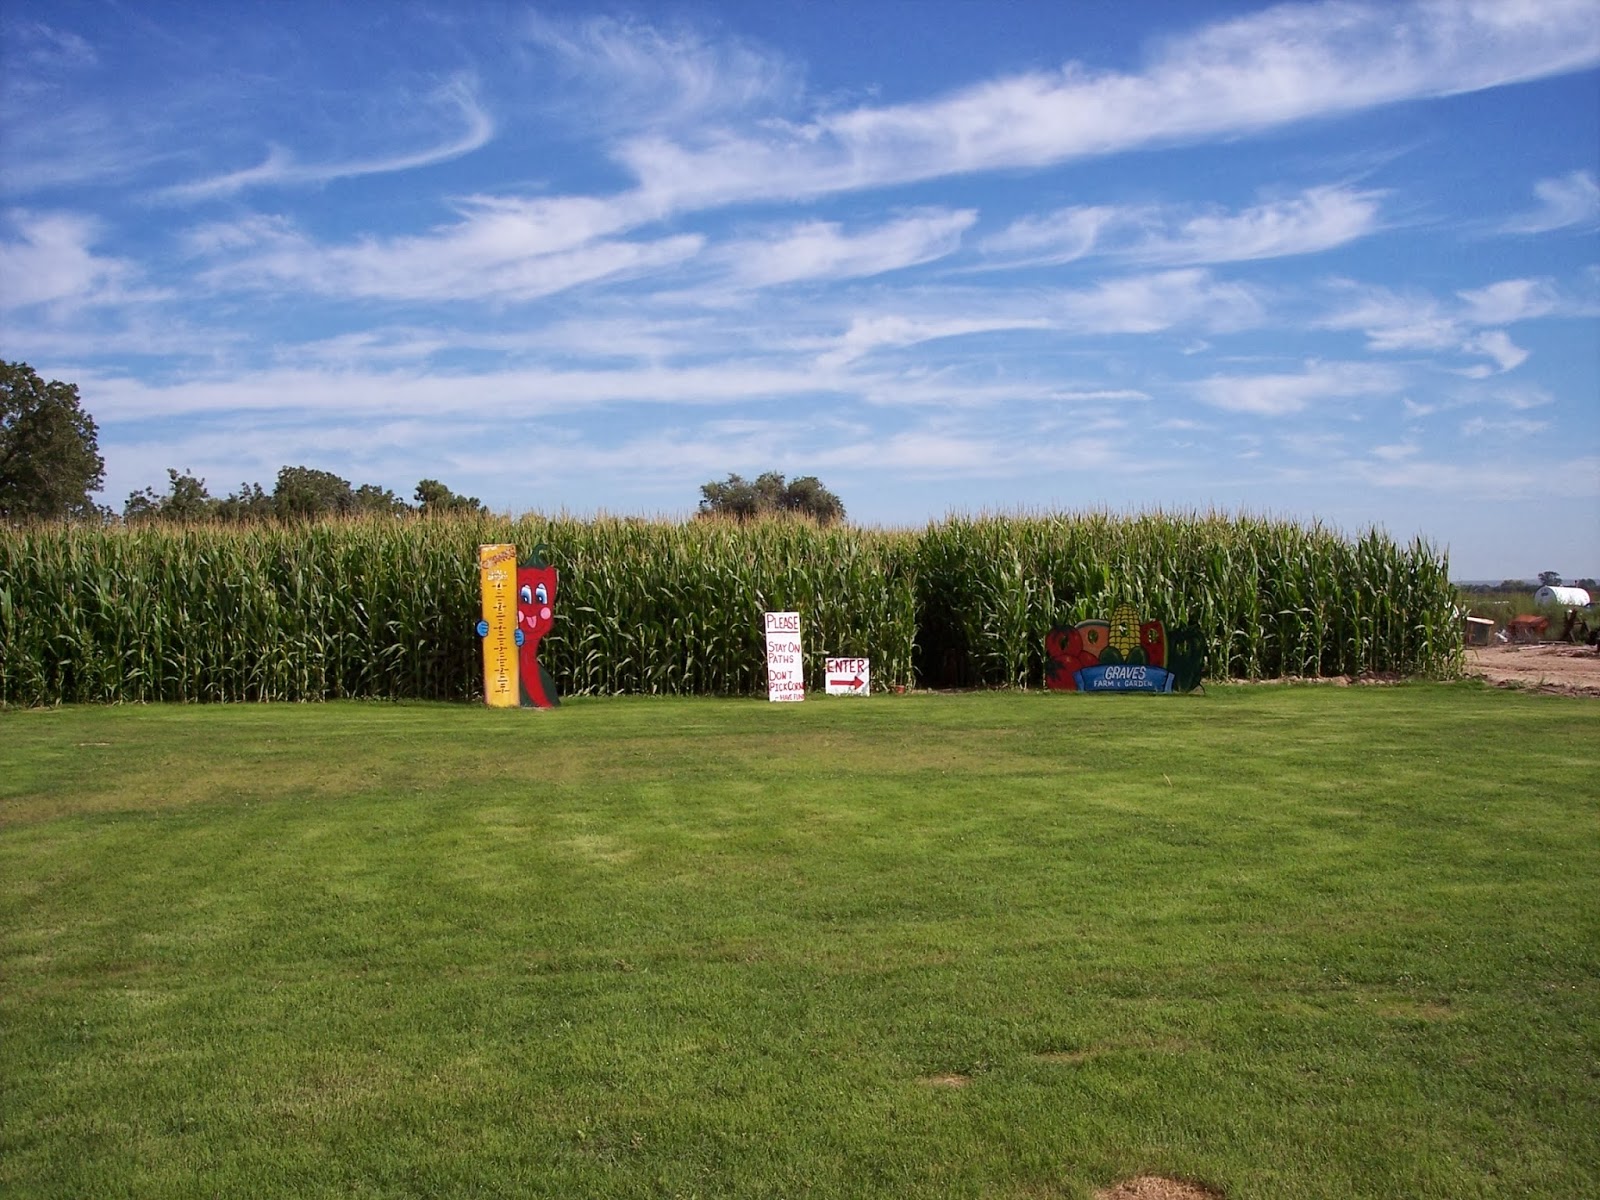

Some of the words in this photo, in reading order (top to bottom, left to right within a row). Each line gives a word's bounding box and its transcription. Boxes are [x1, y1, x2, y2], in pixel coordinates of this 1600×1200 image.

[767, 614, 798, 629] PLEASE
[768, 641, 787, 653] STAY
[788, 641, 801, 653] ON
[768, 653, 794, 664] PATHS
[827, 659, 865, 673] ENTER
[1105, 666, 1146, 680] GRAVES
[769, 681, 787, 692] PICK
